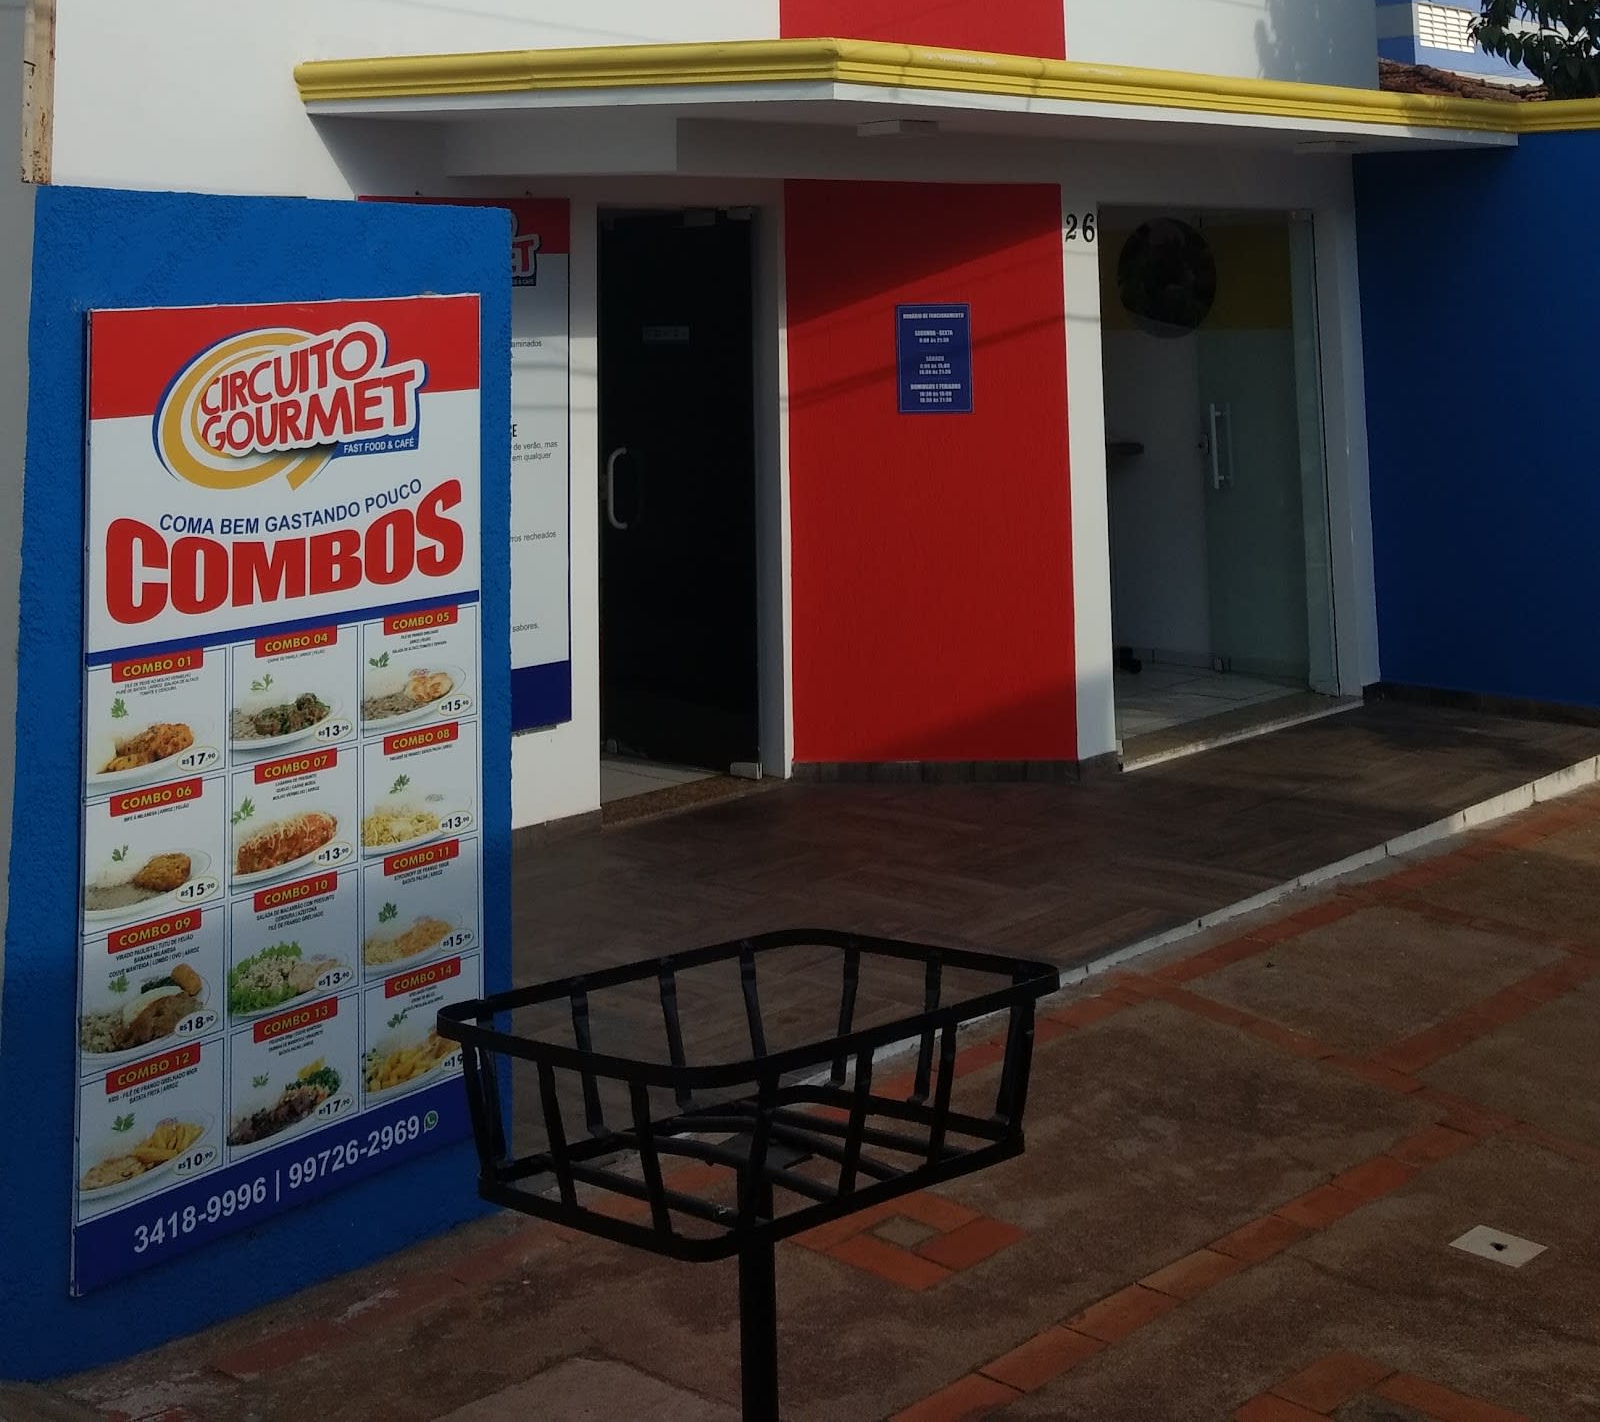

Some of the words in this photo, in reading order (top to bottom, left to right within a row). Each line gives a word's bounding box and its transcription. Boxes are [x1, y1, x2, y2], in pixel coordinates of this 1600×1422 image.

[1065, 213, 1095, 242] 26
[511, 340, 542, 348] aminados
[202, 329, 377, 417] CIRCUITO
[202, 369, 415, 452] GOURMET
[344, 443, 363, 453] FAST
[365, 441, 386, 451] FOOD
[387, 441, 393, 450] &
[395, 436, 414, 448] CAFÉ
[524, 452, 551, 462] qualquer
[160, 513, 214, 534] COMA
[220, 514, 259, 534] BEM
[265, 503, 360, 533] GASTANDO
[365, 479, 421, 513] POUCO
[524, 531, 556, 541] recheados
[106, 479, 463, 625] COMBOS
[392, 615, 434, 630] COMBO
[437, 612, 449, 622] 05
[265, 636, 310, 652] COMBO
[314, 632, 328, 643] 04
[122, 660, 173, 677] COMBO
[177, 656, 191, 667] 01
[392, 733, 434, 750] COMBO
[437, 729, 450, 739] 08
[264, 760, 310, 778] COMBO
[314, 755, 328, 767] 07
[121, 790, 172, 810] COMBO
[176, 785, 192, 797] 06
[393, 850, 434, 870] COMBO
[440, 846, 449, 858] 11
[264, 885, 310, 905] COMBO
[315, 879, 328, 891] 10
[119, 923, 170, 946] COMBO
[175, 917, 191, 931] 09
[394, 971, 436, 991] COMBO
[440, 965, 452, 977] 14
[264, 1012, 310, 1035] COMBO
[315, 1005, 328, 1018] 13
[118, 1059, 169, 1086] COMBO
[176, 1052, 190, 1065] 12
[133, 1179, 267, 1254] 3418-9996
[289, 1114, 420, 1190] 99726-2969
